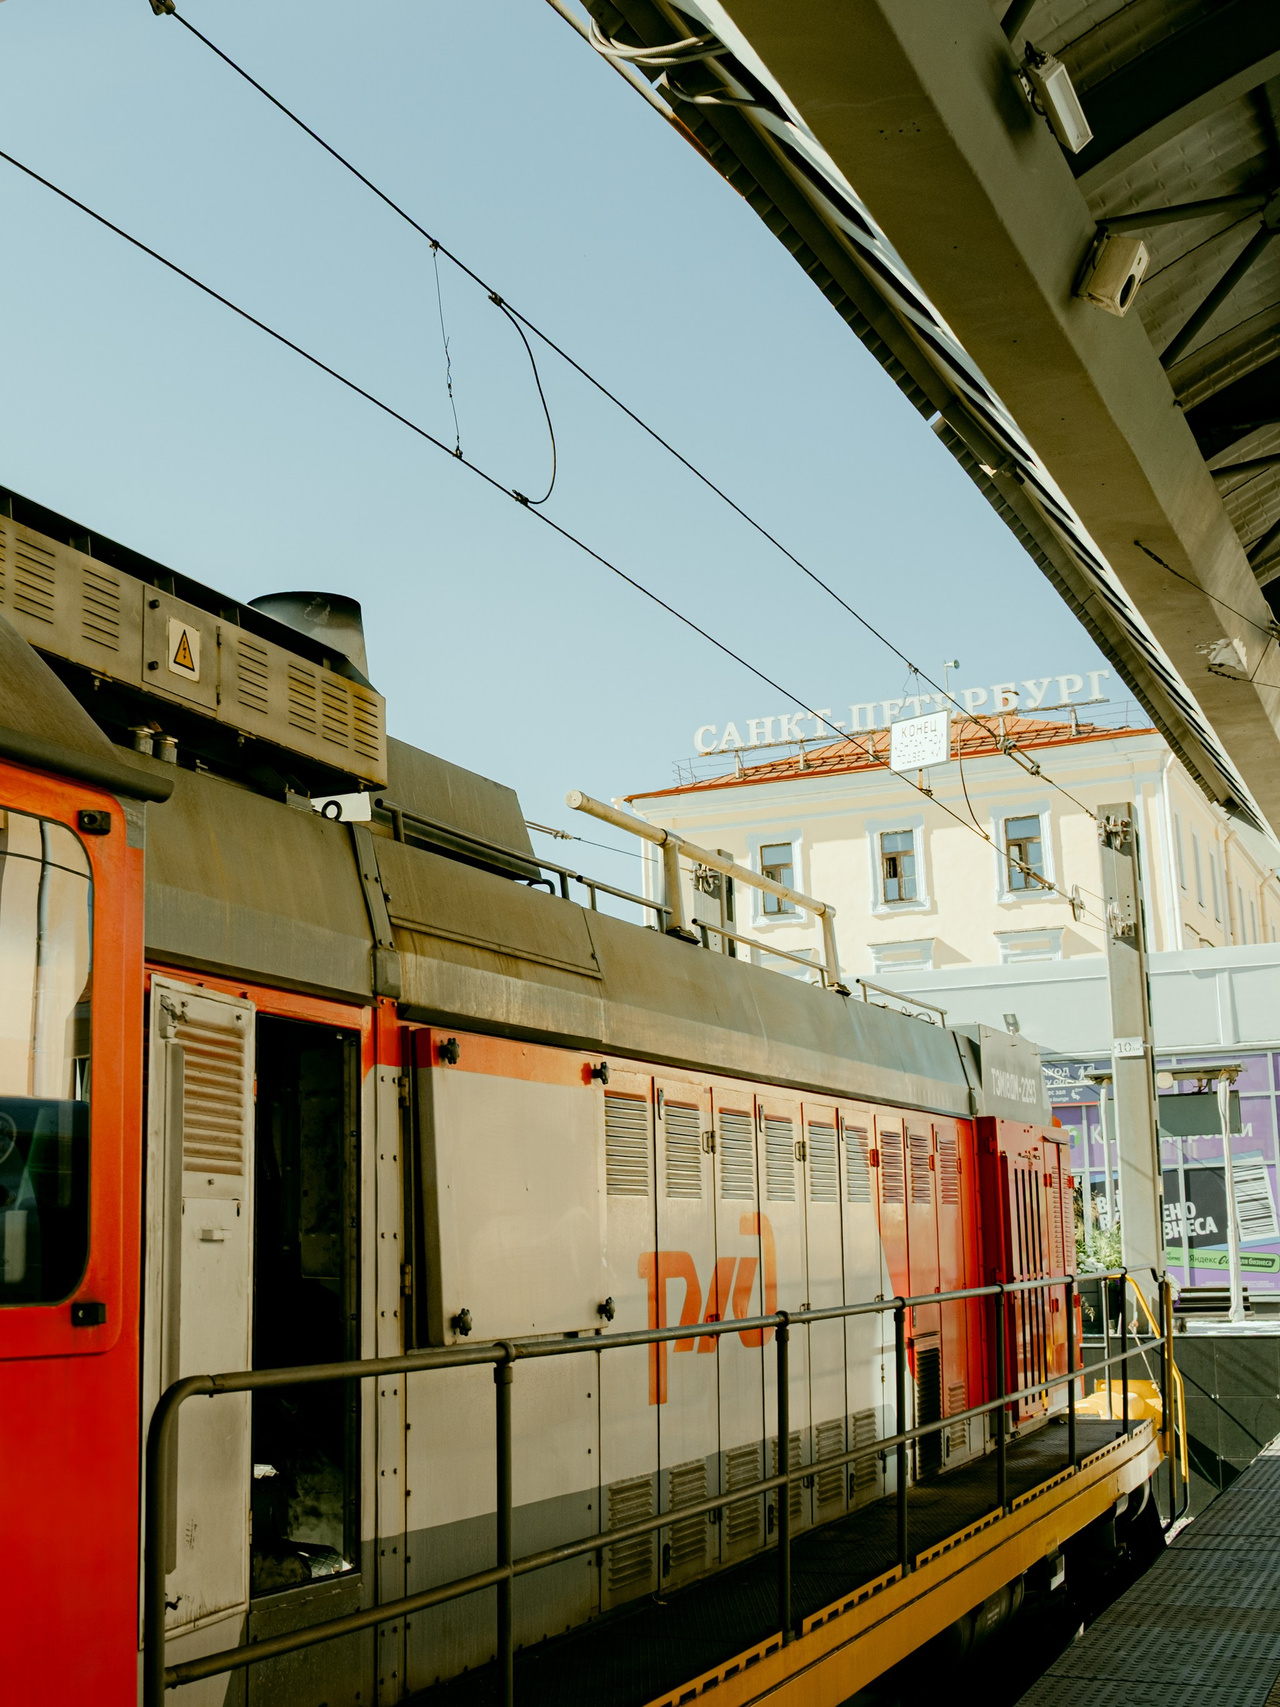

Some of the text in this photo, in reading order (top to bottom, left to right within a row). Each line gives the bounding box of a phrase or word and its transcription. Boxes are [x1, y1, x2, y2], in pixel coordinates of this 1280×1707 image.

[693, 669, 1110, 753] САНКТ-ПЕТЕРБУРГ
[901, 719, 937, 738] КОНЕЦ
[1189, 1254, 1217, 1264] Яндекс
